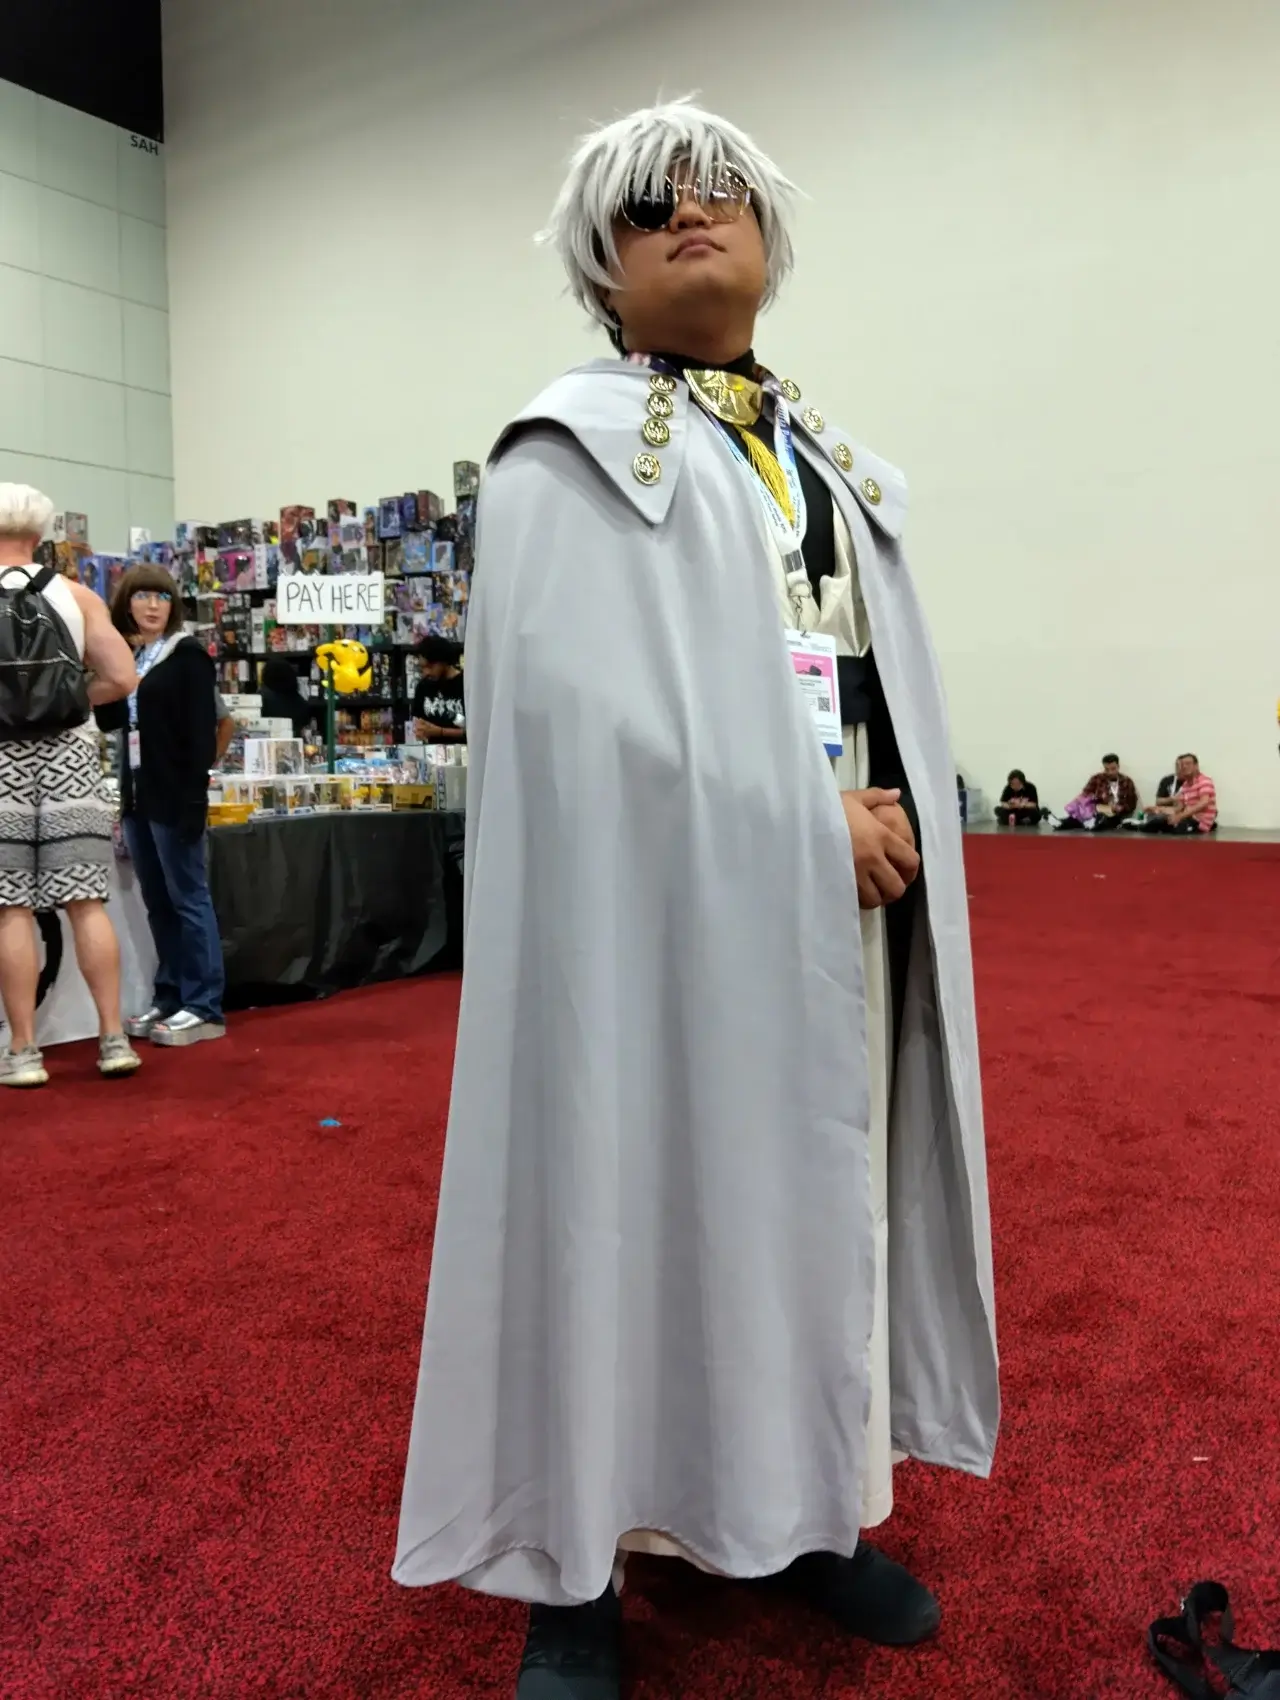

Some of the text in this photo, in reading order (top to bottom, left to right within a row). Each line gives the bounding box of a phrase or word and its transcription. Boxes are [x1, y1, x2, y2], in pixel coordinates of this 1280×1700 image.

[130, 134, 159, 156] SAH
[286, 581, 380, 614] PAY HERE
